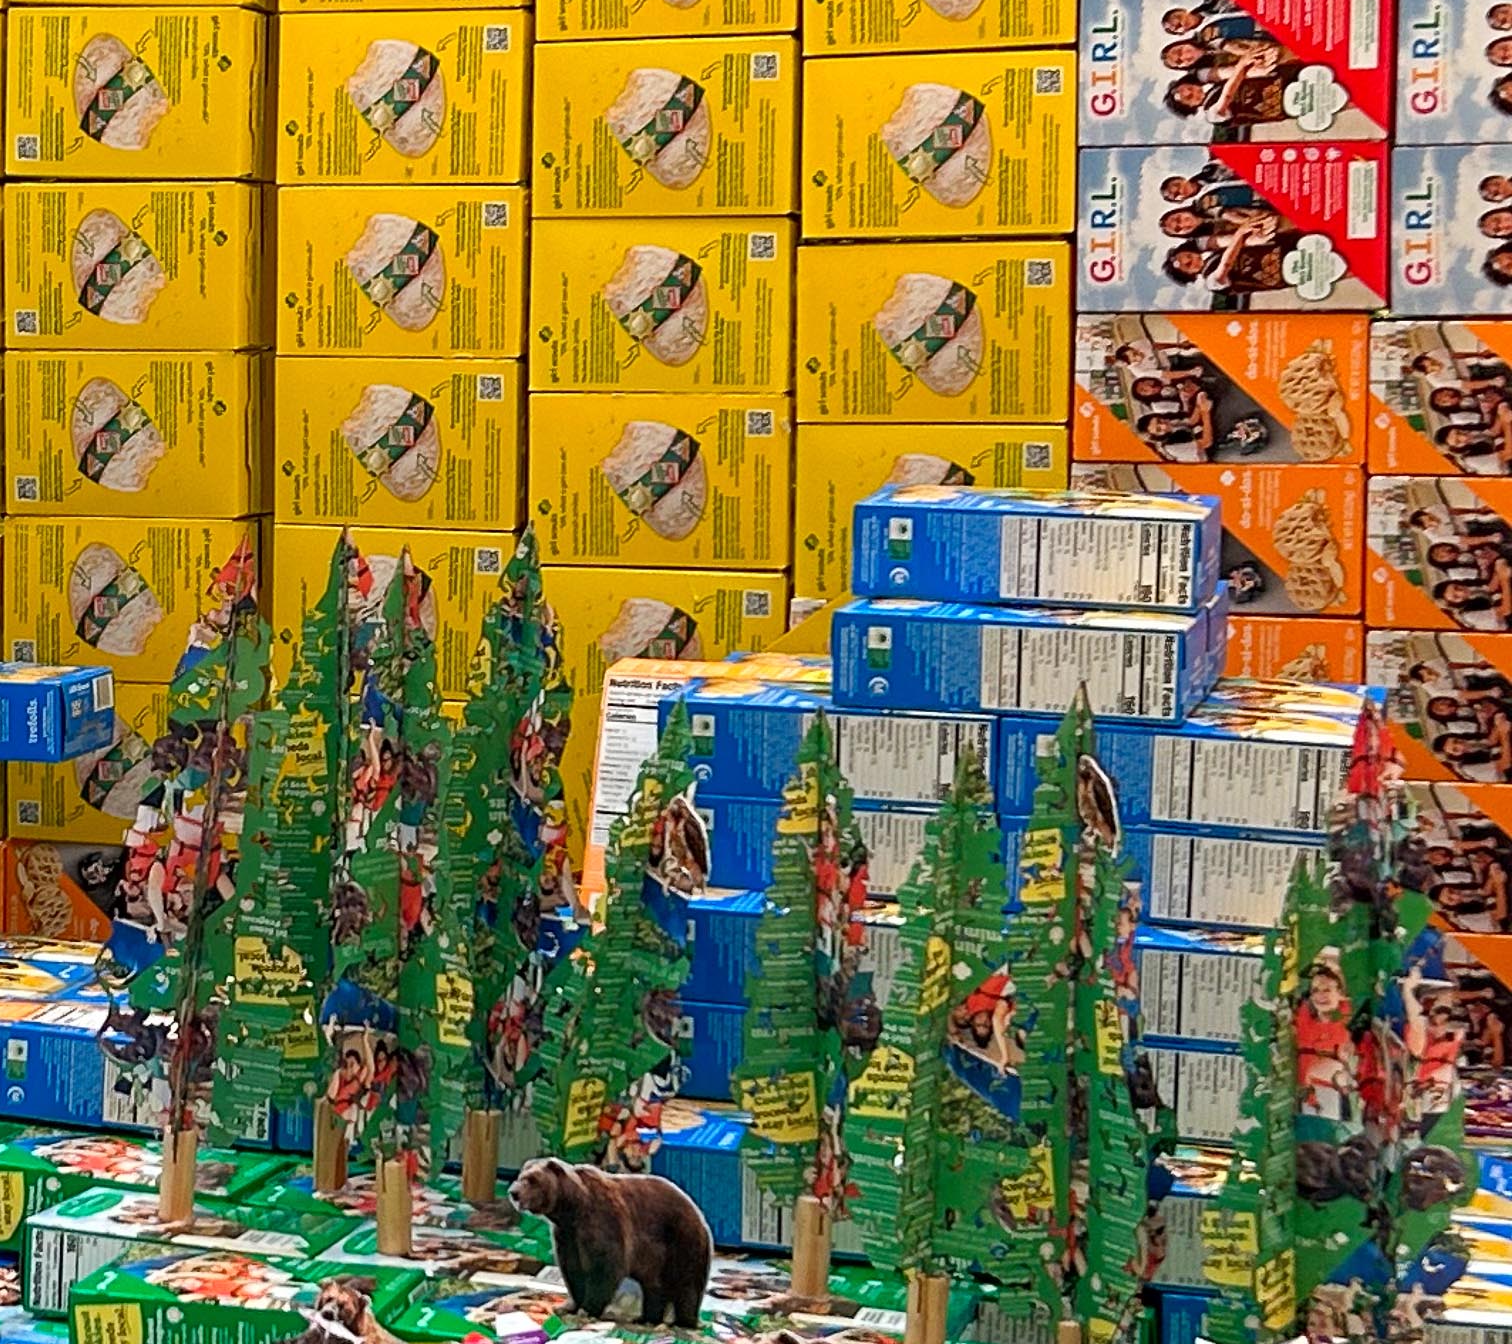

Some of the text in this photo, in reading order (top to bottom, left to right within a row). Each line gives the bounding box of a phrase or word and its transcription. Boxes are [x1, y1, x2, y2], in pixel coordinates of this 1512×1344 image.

[1091, 9, 1118, 117] G.I.R.L.
[1411, 4, 1441, 115] G.I.R.L.
[1090, 177, 1117, 283] G.I.R.L.
[1404, 176, 1434, 286] G.I.R.L.
